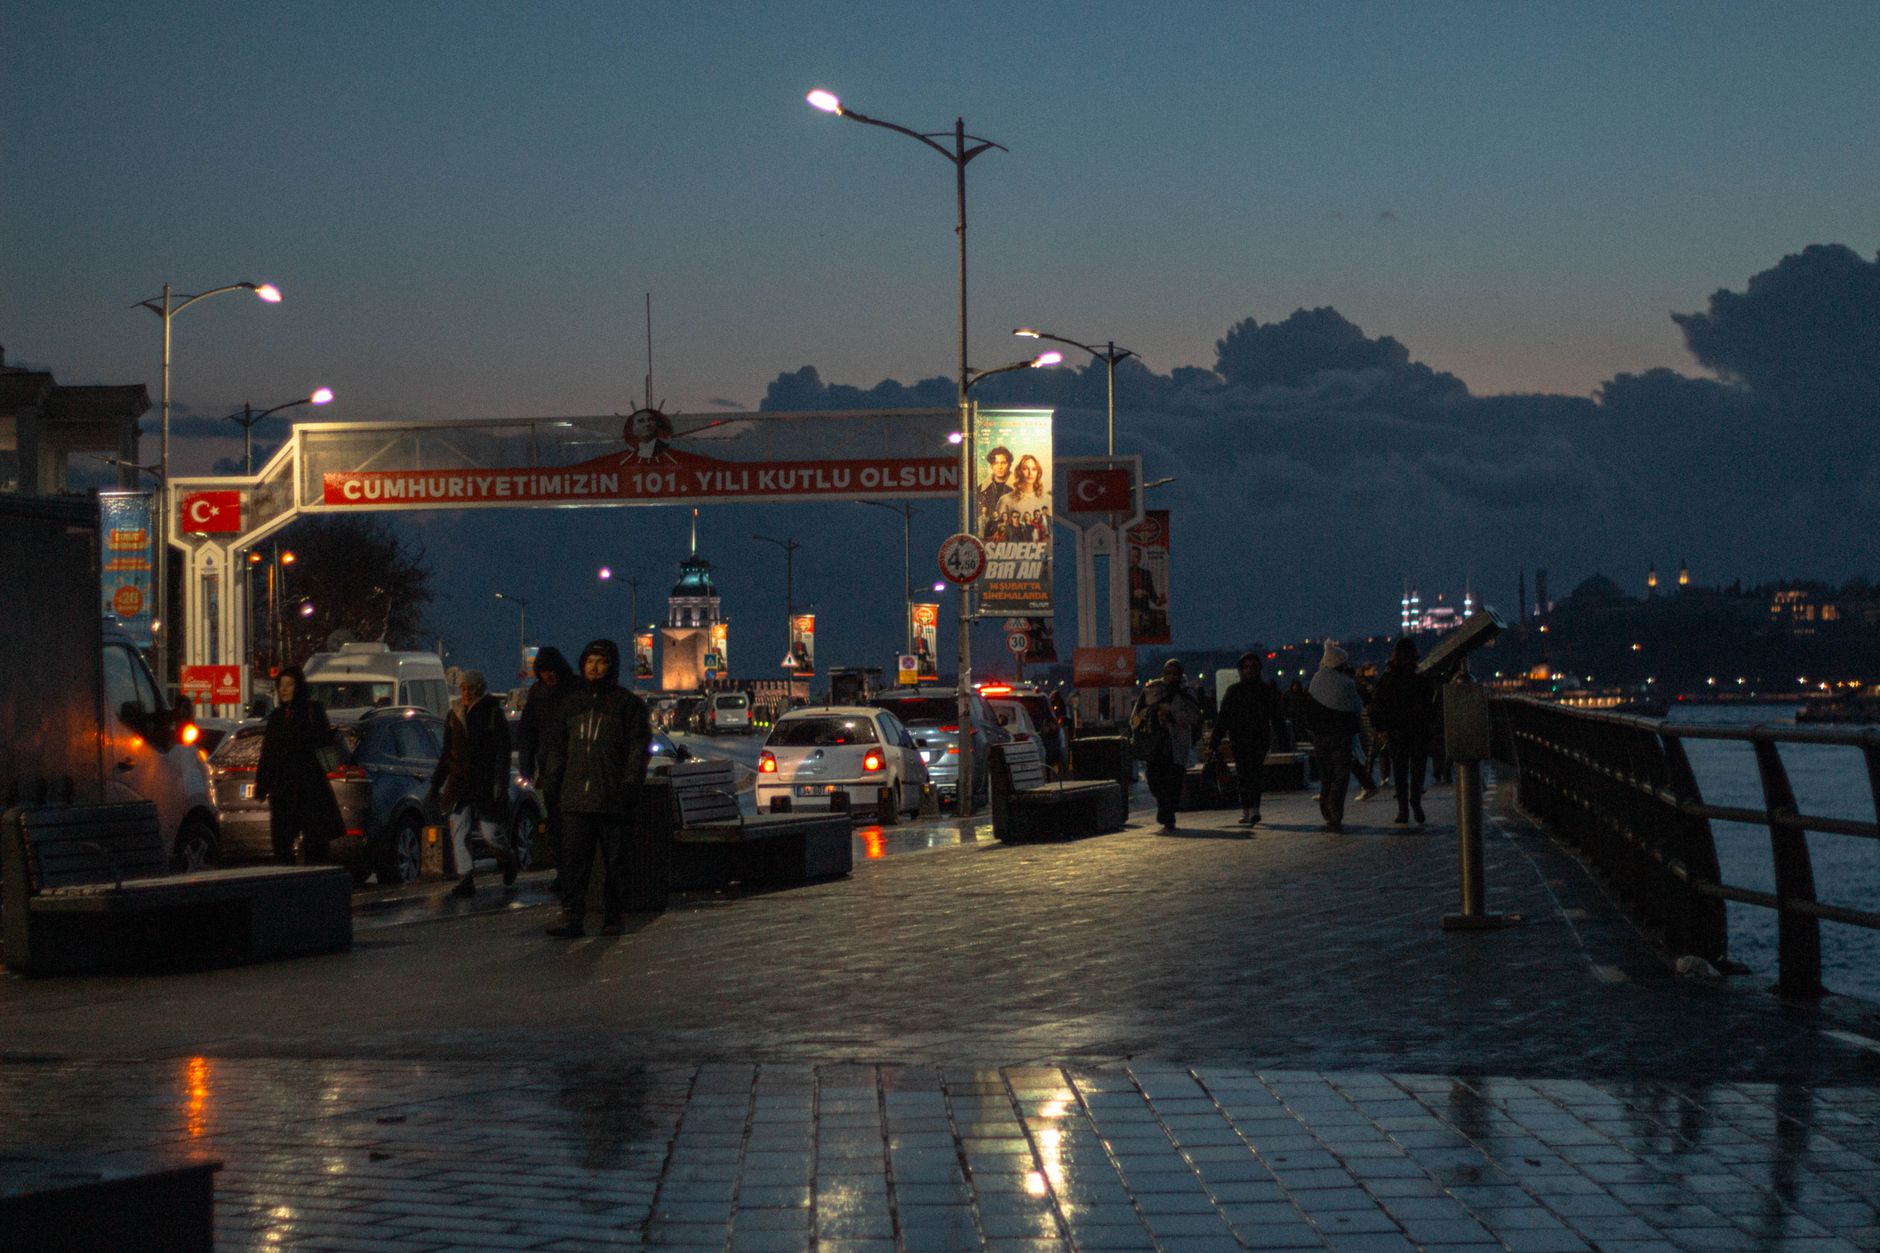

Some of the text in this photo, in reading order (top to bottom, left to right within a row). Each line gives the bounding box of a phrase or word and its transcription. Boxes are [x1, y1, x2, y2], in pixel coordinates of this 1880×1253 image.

[632, 472, 688, 493] 101.
[696, 470, 749, 492] YILI
[759, 467, 850, 490] KUTLU
[860, 466, 959, 488] OLSUN
[1016, 561, 1042, 579] AN
[1011, 636, 1025, 649] 30
